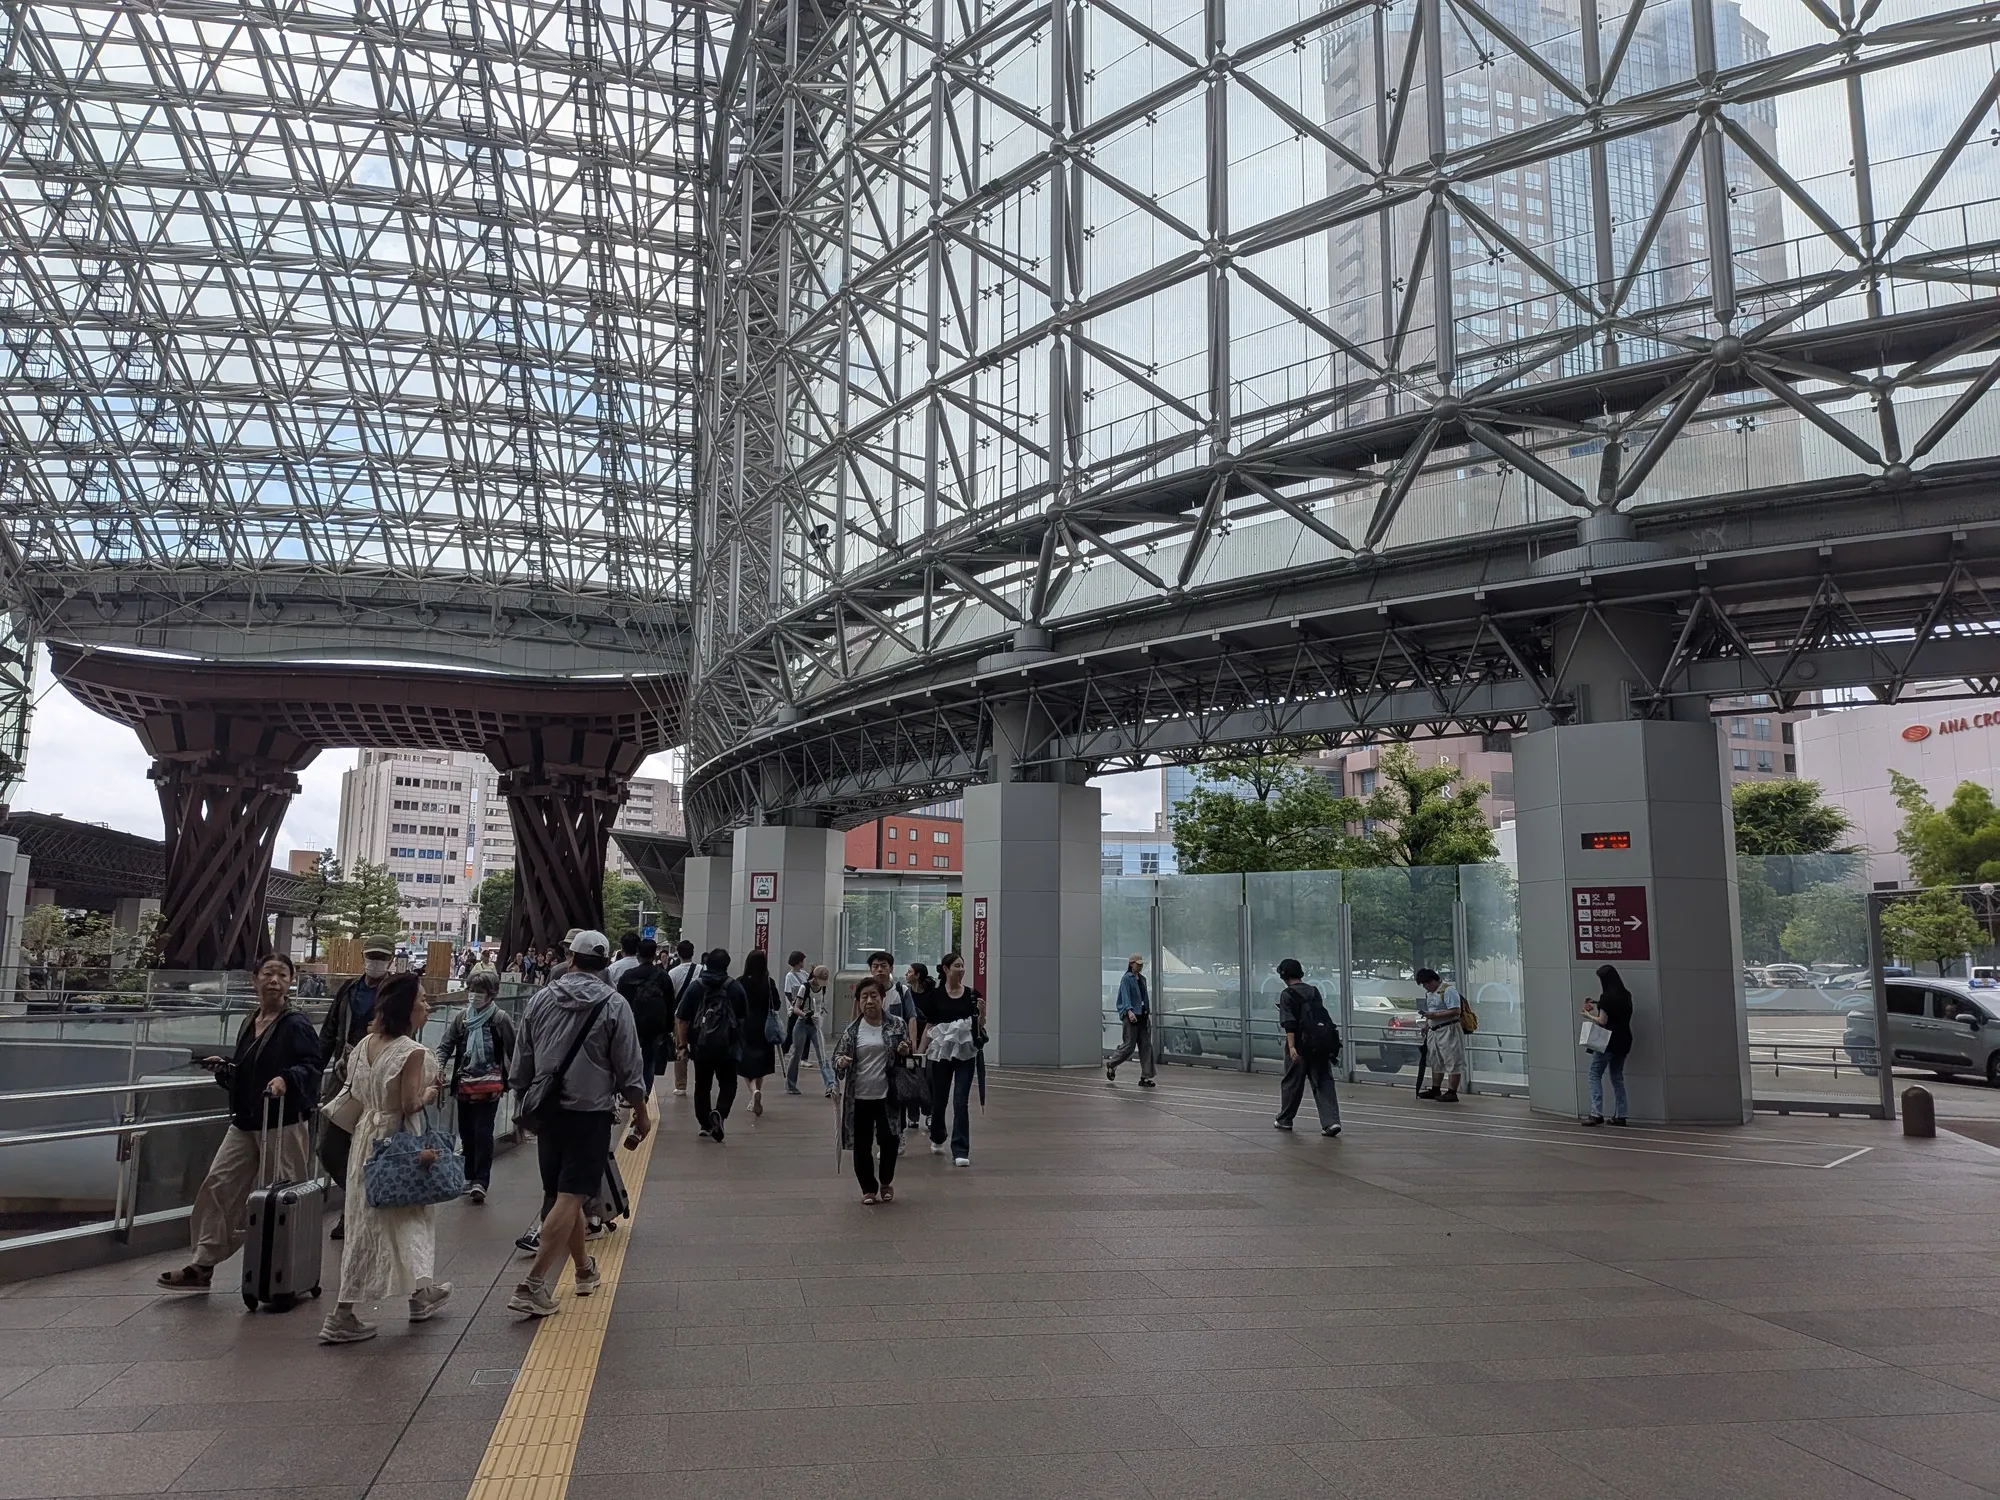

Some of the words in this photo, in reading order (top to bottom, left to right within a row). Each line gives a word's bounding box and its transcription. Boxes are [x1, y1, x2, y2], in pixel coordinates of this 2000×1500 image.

[1939, 718, 1969, 735] ANA
[1593, 925, 1621, 933] まちのり
